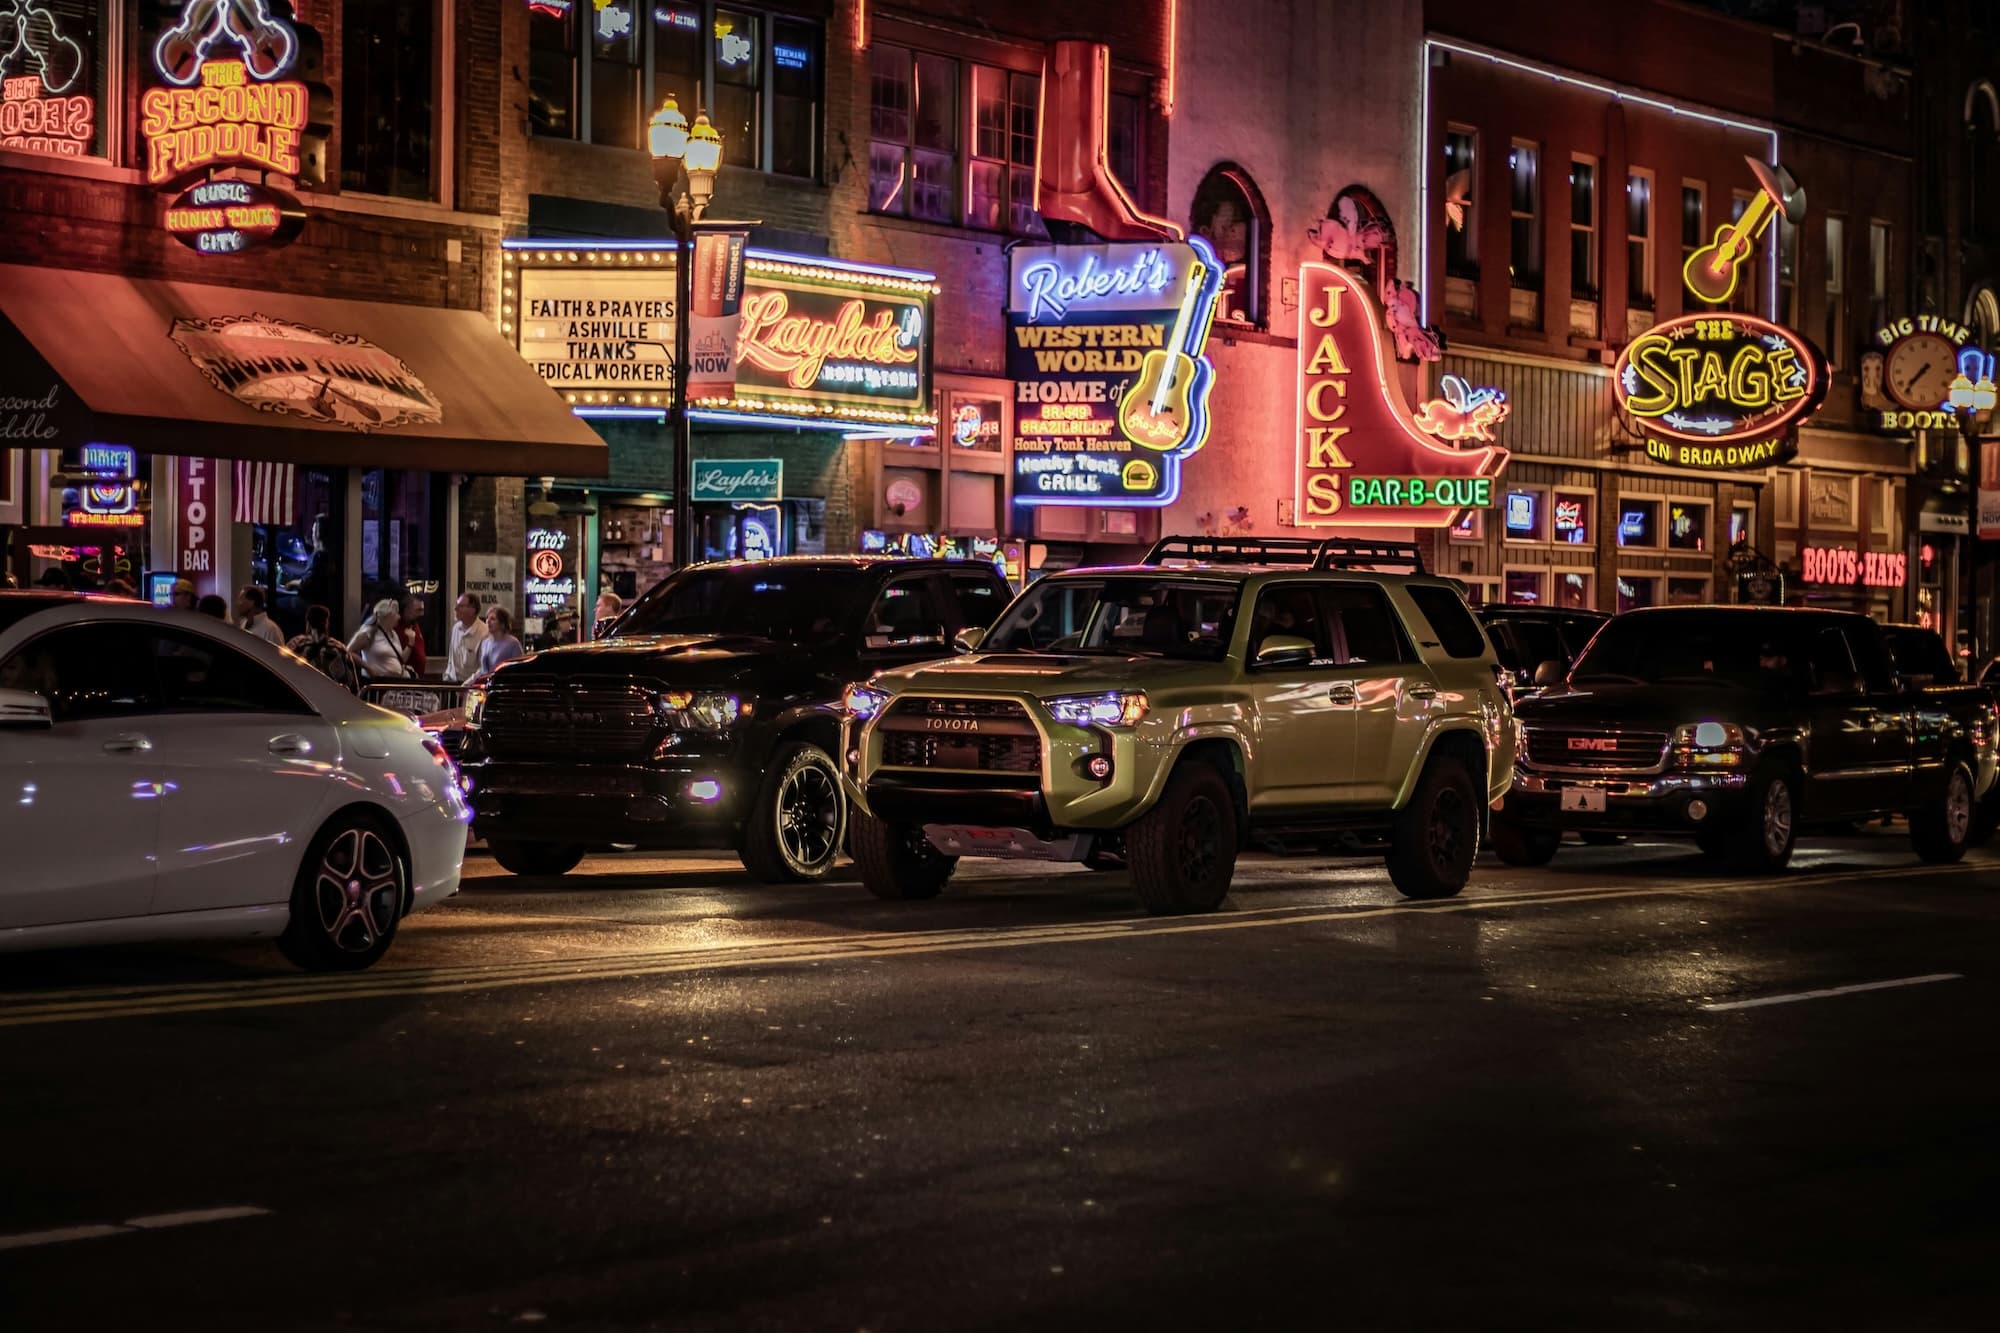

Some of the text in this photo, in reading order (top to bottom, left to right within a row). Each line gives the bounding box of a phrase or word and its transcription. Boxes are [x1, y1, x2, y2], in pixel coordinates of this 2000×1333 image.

[201, 61, 247, 87] THE
[143, 83, 309, 136] SECOND
[149, 123, 298, 182] FIDDLE
[194, 183, 250, 205] MUSIC
[165, 205, 279, 231] HONKY TONK
[200, 232, 241, 250] CITY
[726, 242, 741, 302] Reconnect.
[1021, 249, 1176, 322] Robert's
[531, 300, 674, 318] FAITH & PRAYERS
[264, 326, 288, 338] THE
[568, 322, 648, 339] ASHVILLE
[735, 291, 918, 389] Layla's
[1014, 325, 1165, 348] WESTERN
[1695, 321, 1733, 340] THE
[1878, 315, 1970, 345] BIG TIME
[567, 342, 636, 361] THANKS
[1034, 351, 1143, 373] WORLD
[530, 362, 592, 380] EDICAL
[694, 358, 730, 373] NOW
[1627, 335, 1807, 416] STAGE
[1017, 378, 1129, 407] HOME of
[1305, 286, 1354, 515] JACKS
[1881, 410, 1961, 430] BOOTS
[1014, 437, 1132, 454] Honky Tonk Heaven
[1647, 438, 1778, 465] ON BROADWAY
[1018, 454, 1121, 476] Honky Tonk
[697, 469, 778, 495] Layla's
[1038, 473, 1099, 491] GRILL
[1351, 479, 1490, 506] BAR-B-QUE
[529, 530, 567, 549] Tito's
[184, 550, 209, 570] BAR
[1802, 547, 1907, 587] BOOTS HATS
[536, 594, 565, 604] VODKA
[926, 719, 978, 731] TOYOTA
[1568, 738, 1617, 751] GMC
